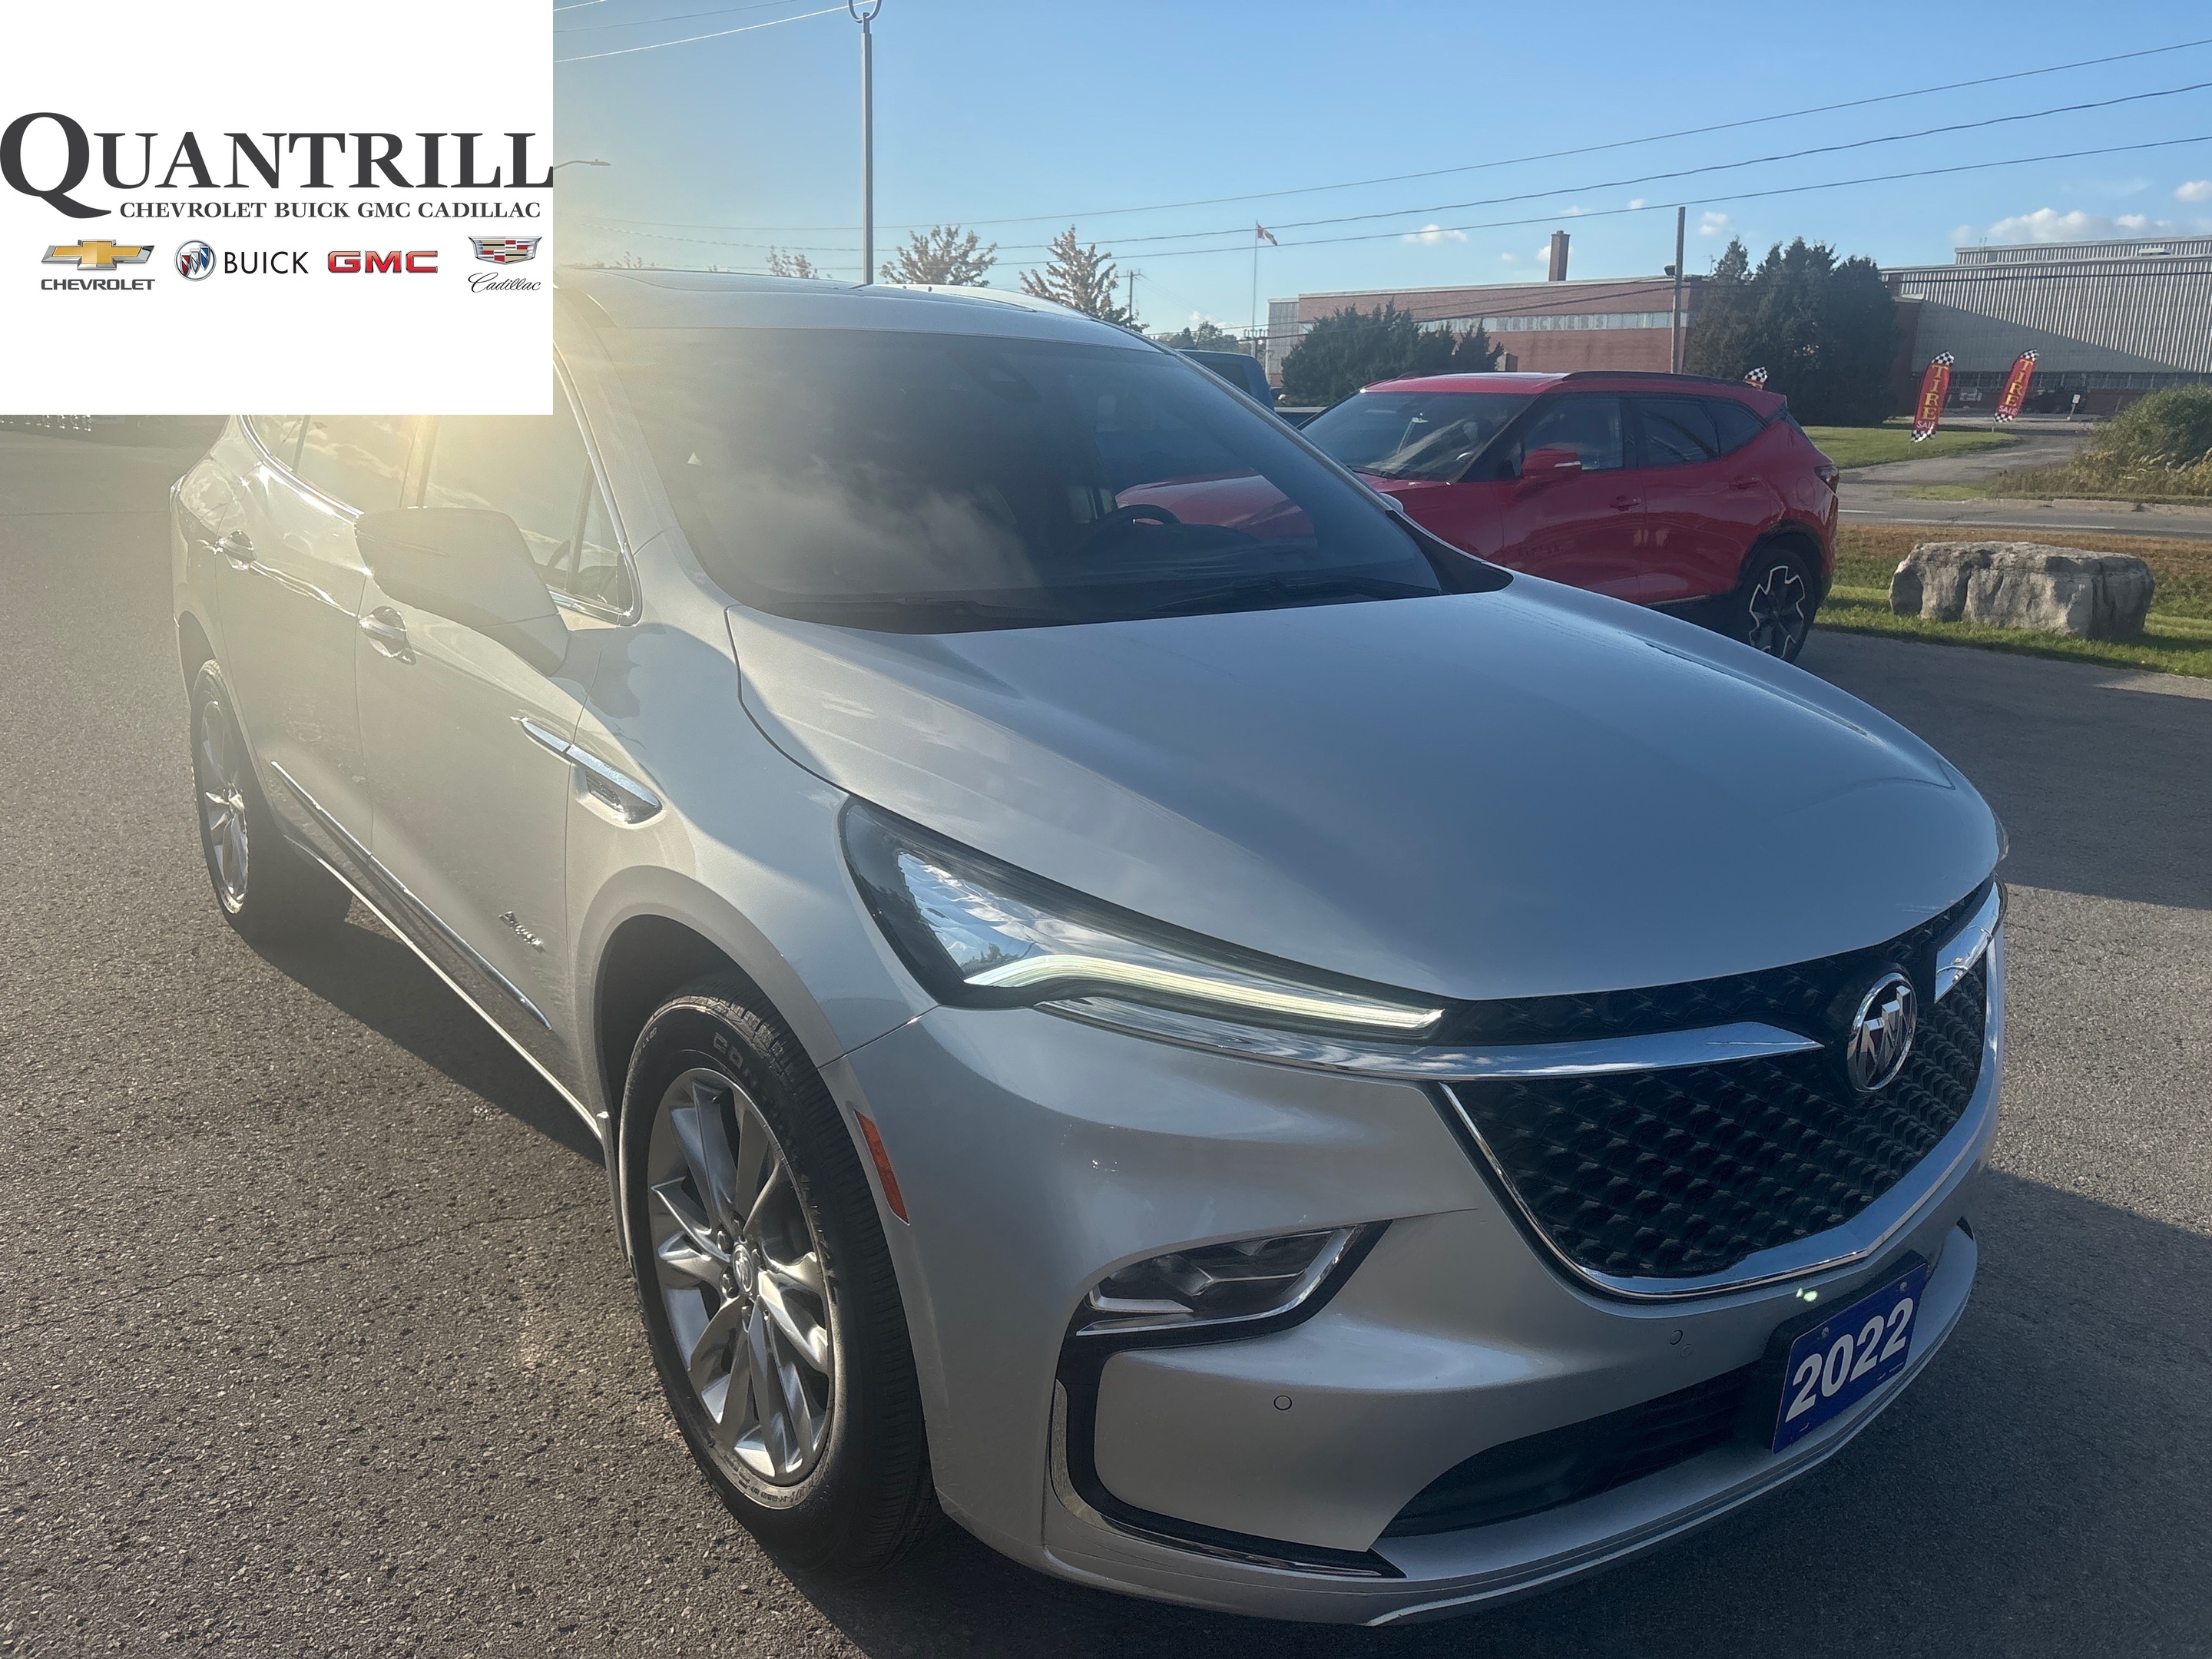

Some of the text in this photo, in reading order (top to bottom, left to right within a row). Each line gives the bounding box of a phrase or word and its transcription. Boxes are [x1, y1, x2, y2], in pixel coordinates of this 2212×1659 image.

[1922, 365, 1949, 420] TIRE
[2005, 359, 2035, 407] TIRE
[1784, 1297, 1914, 1423] 2022
